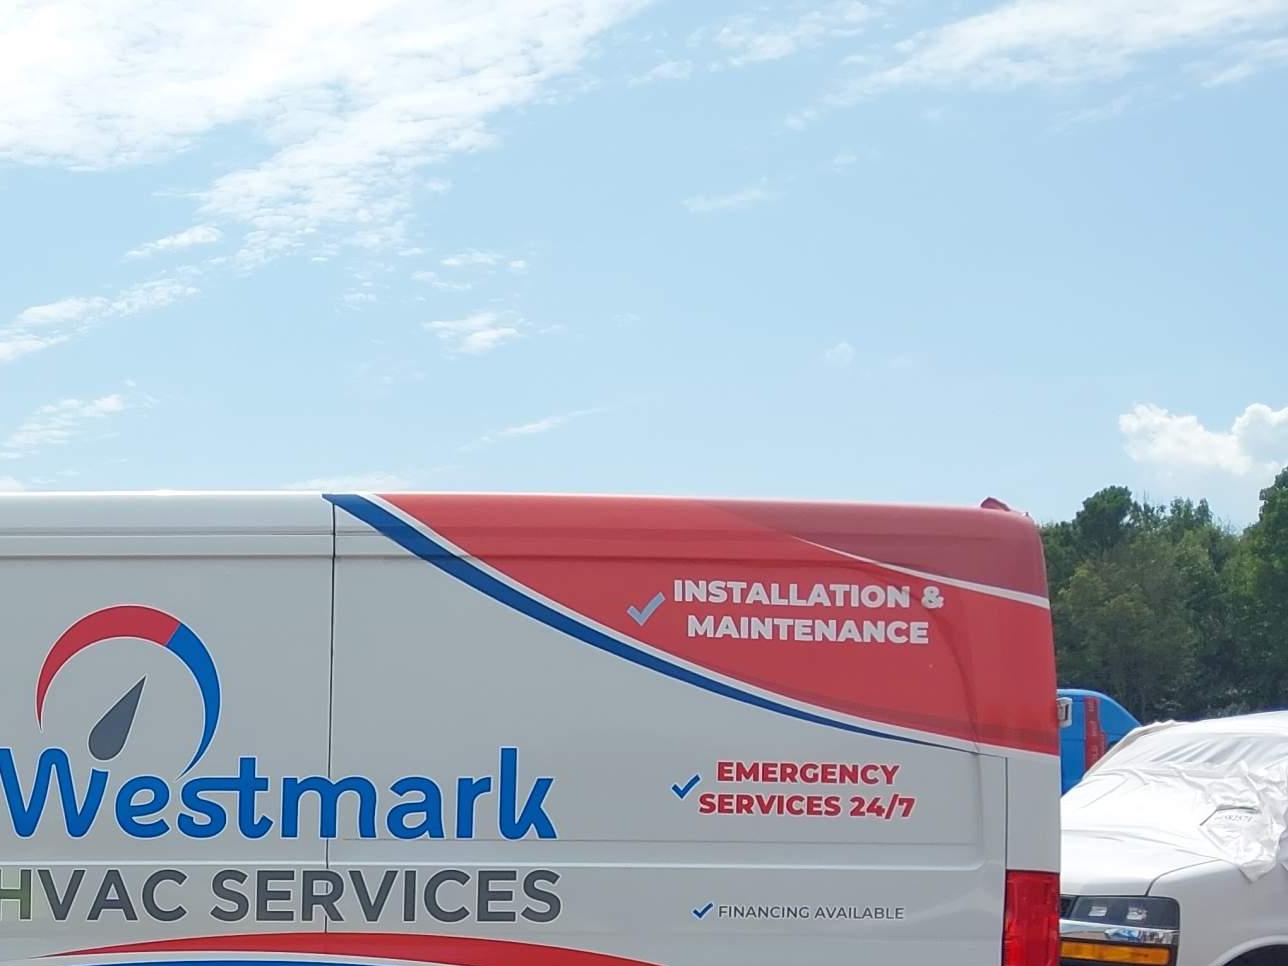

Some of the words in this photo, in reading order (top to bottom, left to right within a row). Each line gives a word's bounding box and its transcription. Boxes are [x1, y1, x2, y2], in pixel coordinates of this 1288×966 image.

[674, 580, 910, 608] INSTALLATION
[921, 586, 944, 609] &
[687, 615, 929, 644] MAINTENANCE
[717, 761, 900, 785] EMERGENCY
[698, 794, 841, 816] SERVICES
[850, 794, 915, 820] 24/7
[210, 869, 563, 923] SERVICES
[718, 905, 810, 919] FINANCING
[814, 907, 905, 920] AVAILABLE
